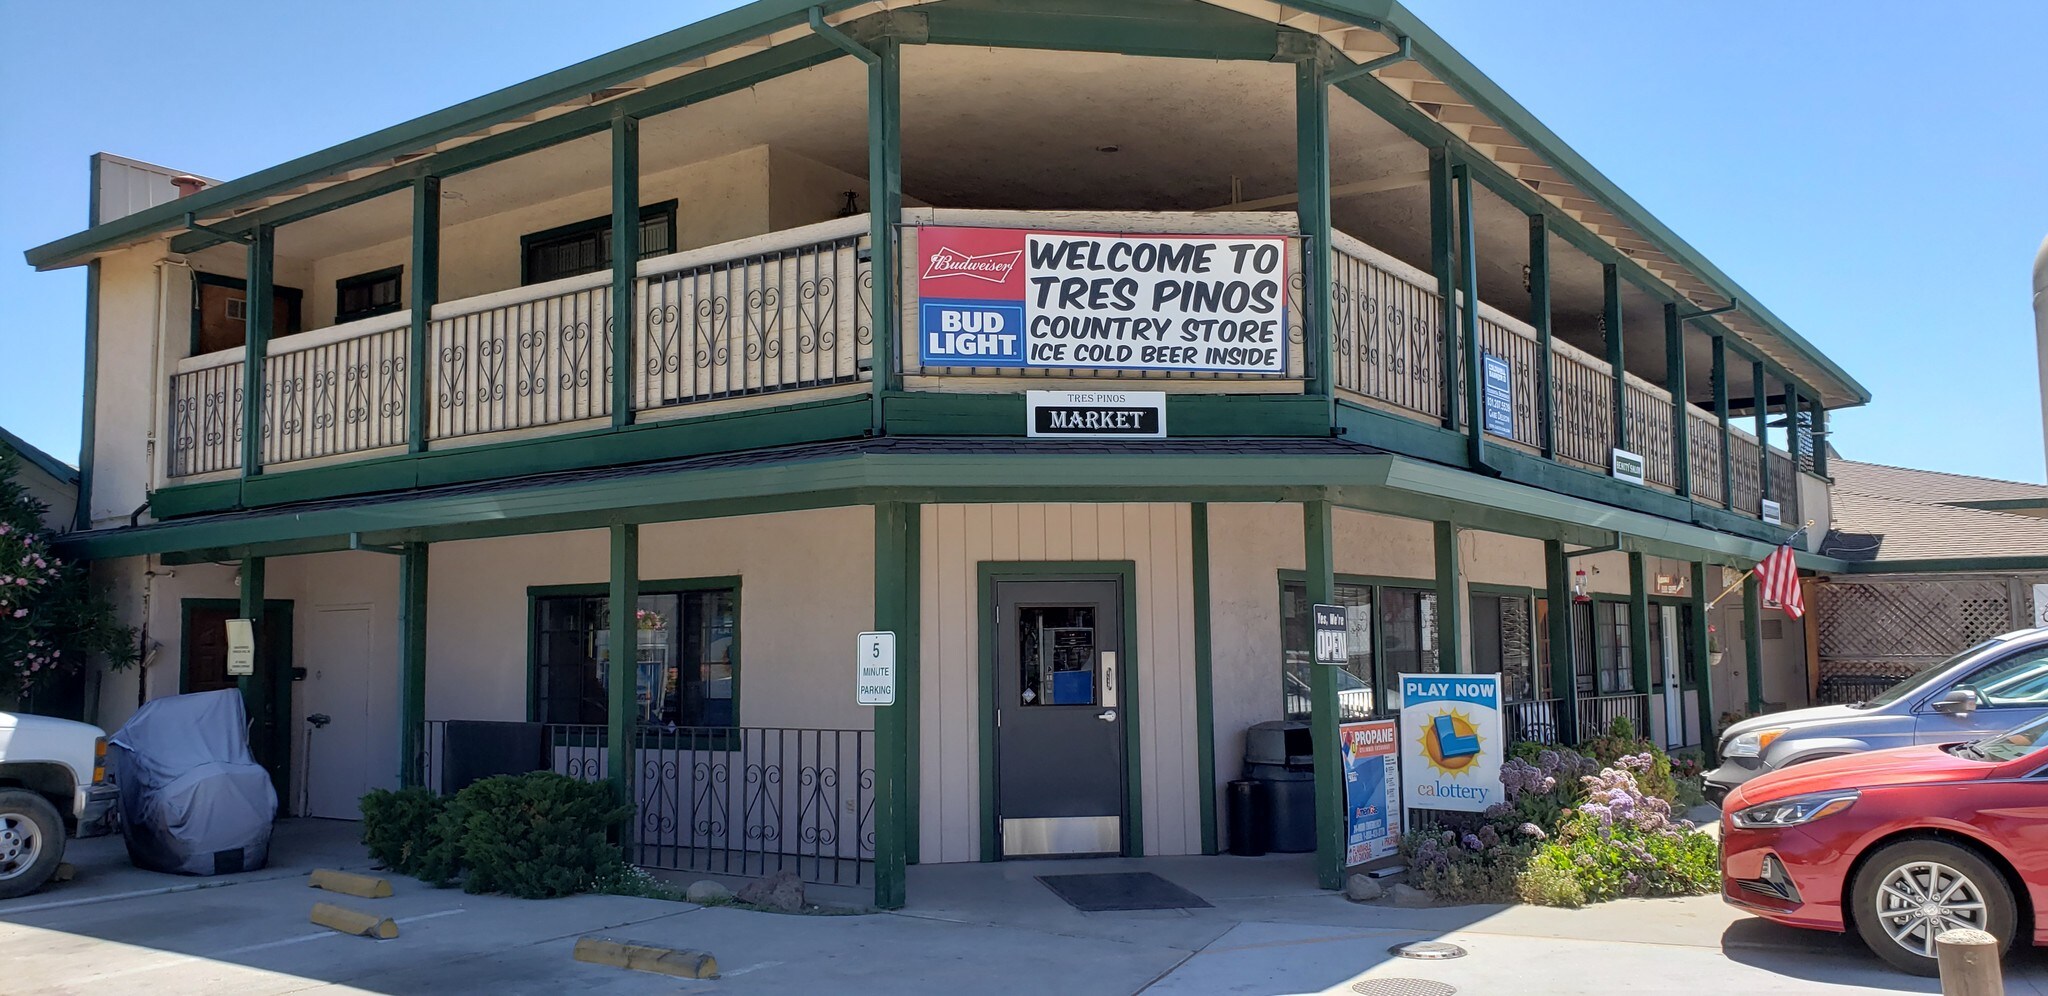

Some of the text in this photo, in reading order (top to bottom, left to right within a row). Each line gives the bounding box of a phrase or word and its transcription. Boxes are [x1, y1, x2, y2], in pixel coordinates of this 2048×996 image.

[931, 254, 1013, 272] Budweiser
[1029, 239, 1279, 275] WELCOME TO
[1030, 276, 1278, 314] TRES PINOS
[941, 310, 1005, 333] BUD
[1030, 314, 1278, 344] COUNTRY STORE
[929, 332, 1017, 356] LIGHT
[1030, 343, 1278, 366] ICE COLD BEER INSIDE
[1067, 393, 1126, 403] TRES PINOS
[1049, 410, 1145, 430] MARKET
[1317, 612, 1329, 626] Yes,
[1329, 613, 1345, 626] We're
[873, 642, 880, 658] 5
[1316, 628, 1347, 661] OPEN
[863, 667, 889, 677] MINUTE
[861, 685, 891, 695] PARKING
[1406, 682, 1495, 698] PLAY NOW
[1354, 727, 1394, 746] PROPANE
[1418, 780, 1490, 804] calottery
